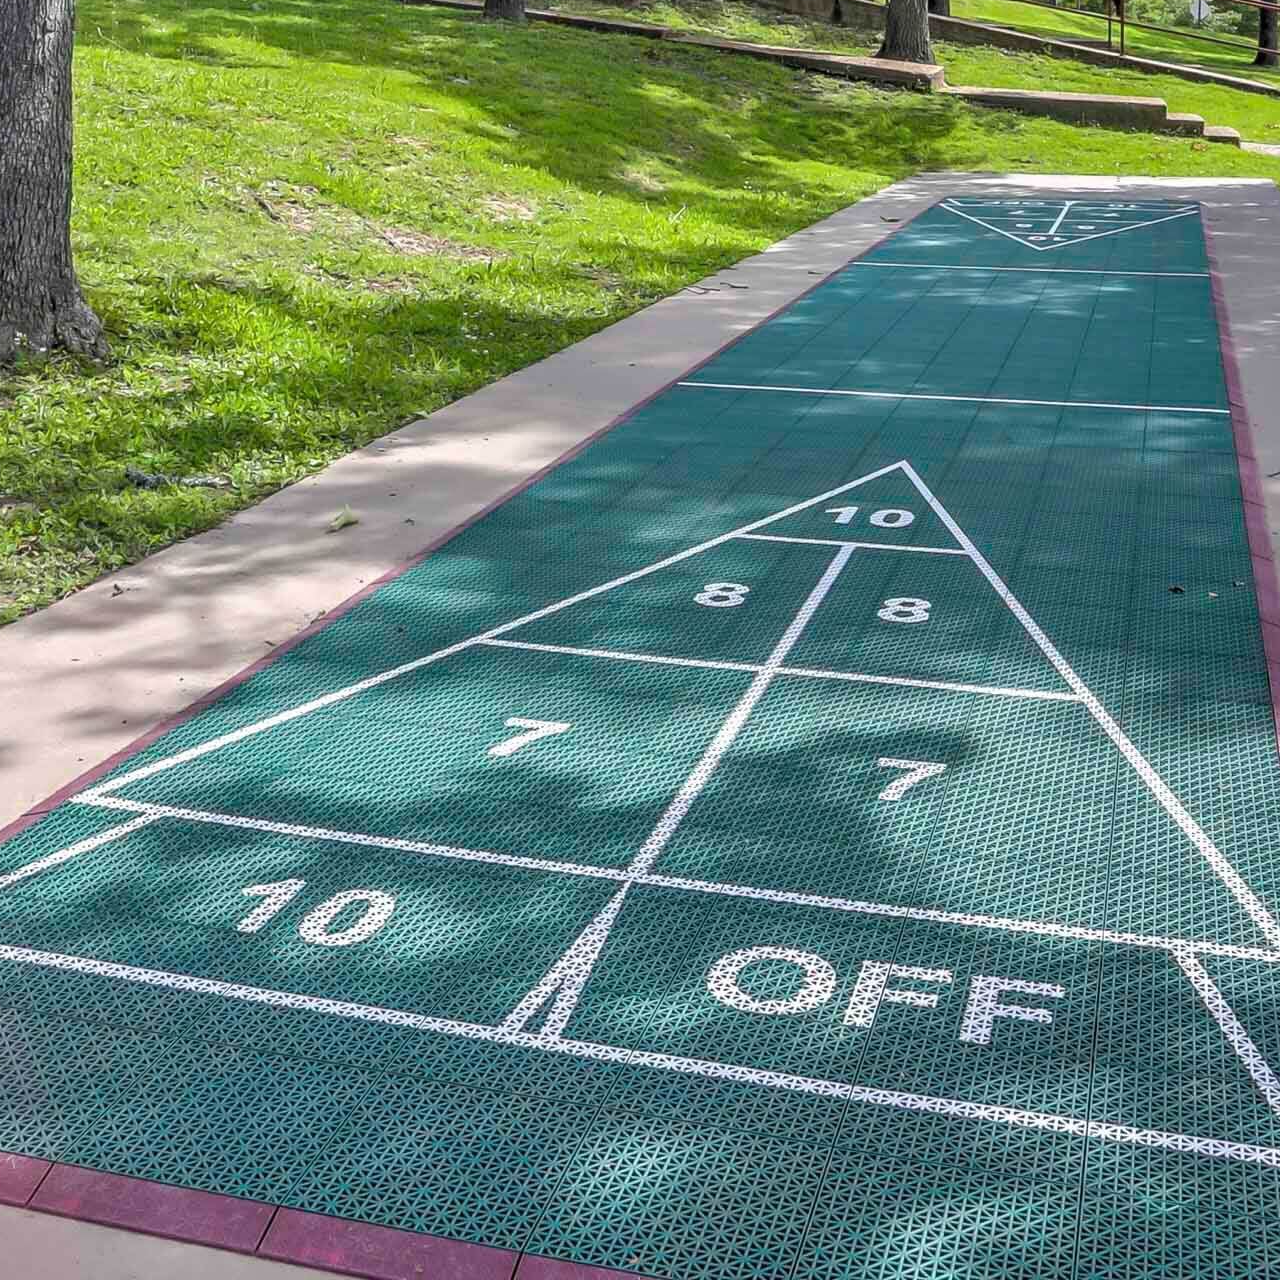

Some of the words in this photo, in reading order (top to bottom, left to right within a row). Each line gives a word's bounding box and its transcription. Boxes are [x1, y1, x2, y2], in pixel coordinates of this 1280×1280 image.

[824, 506, 915, 528] 10
[693, 582, 751, 608] 8
[876, 596, 932, 623] 8
[486, 716, 573, 757] 7
[877, 756, 948, 802] 7
[236, 878, 397, 947] 10
[706, 944, 1066, 1046] OFF
